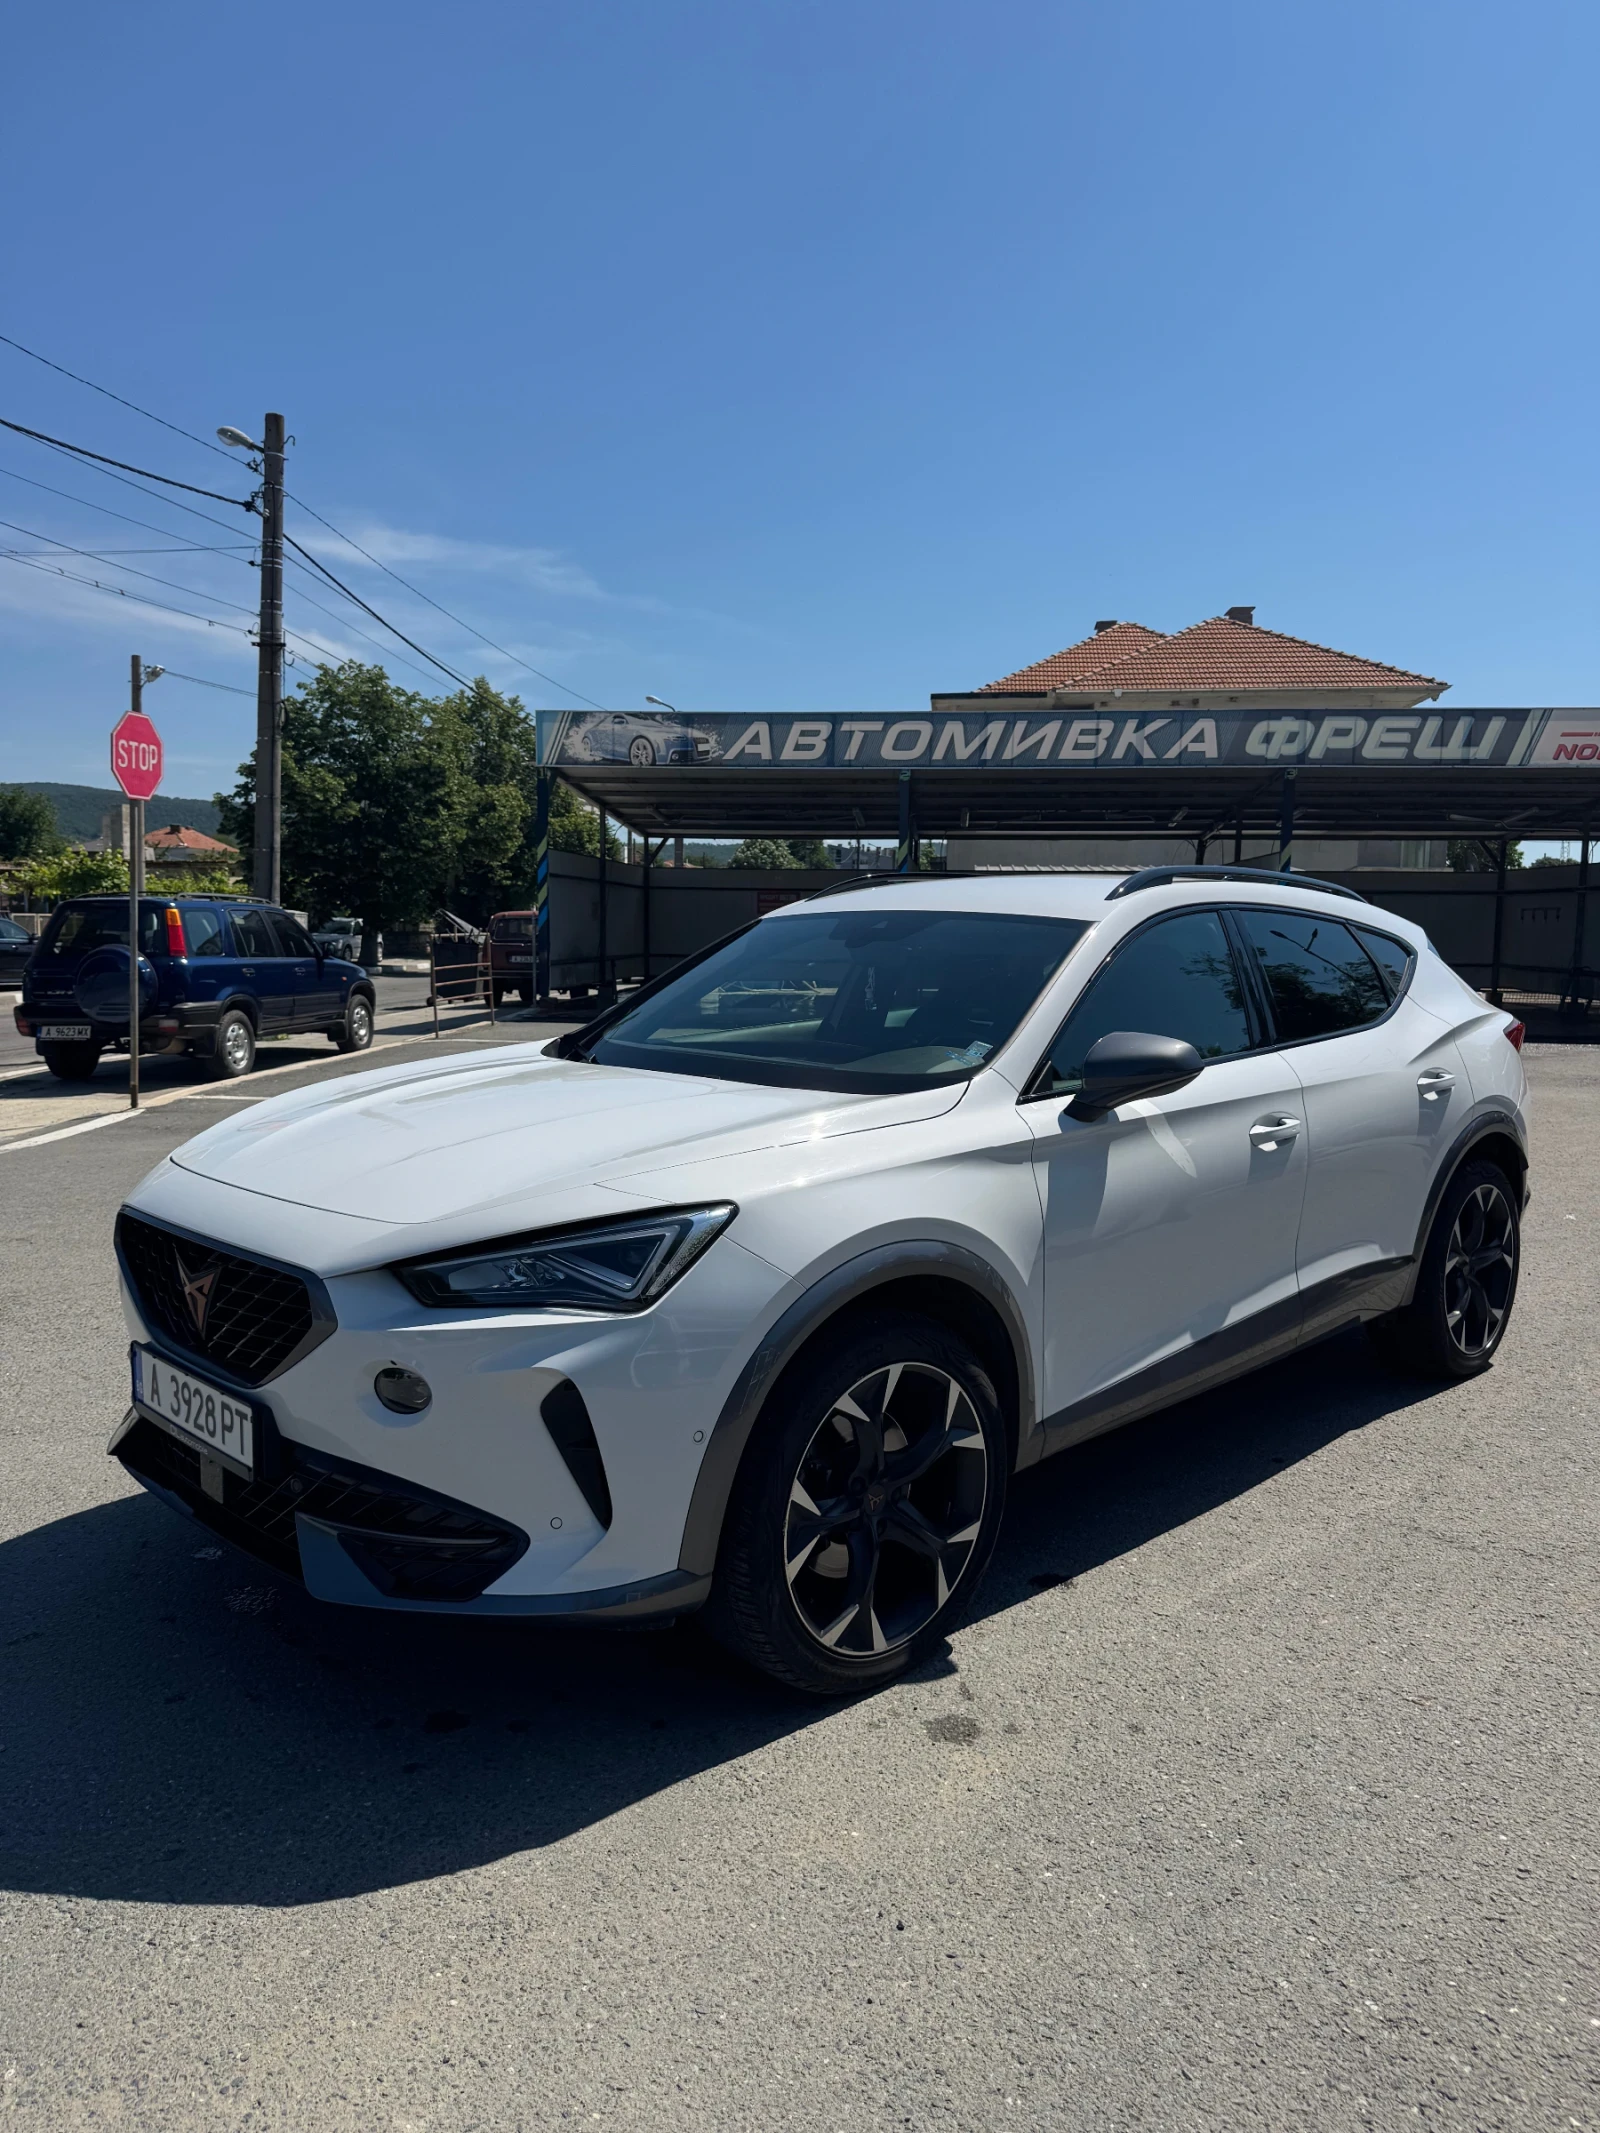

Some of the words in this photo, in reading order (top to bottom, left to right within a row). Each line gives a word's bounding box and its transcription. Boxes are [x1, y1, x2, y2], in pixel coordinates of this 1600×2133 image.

[721, 718, 1218, 761] АВТОМИВКА
[1244, 715, 1507, 760] ФРЕШ
[1552, 743, 1600, 761] NO
[117, 739, 158, 772] STOP
